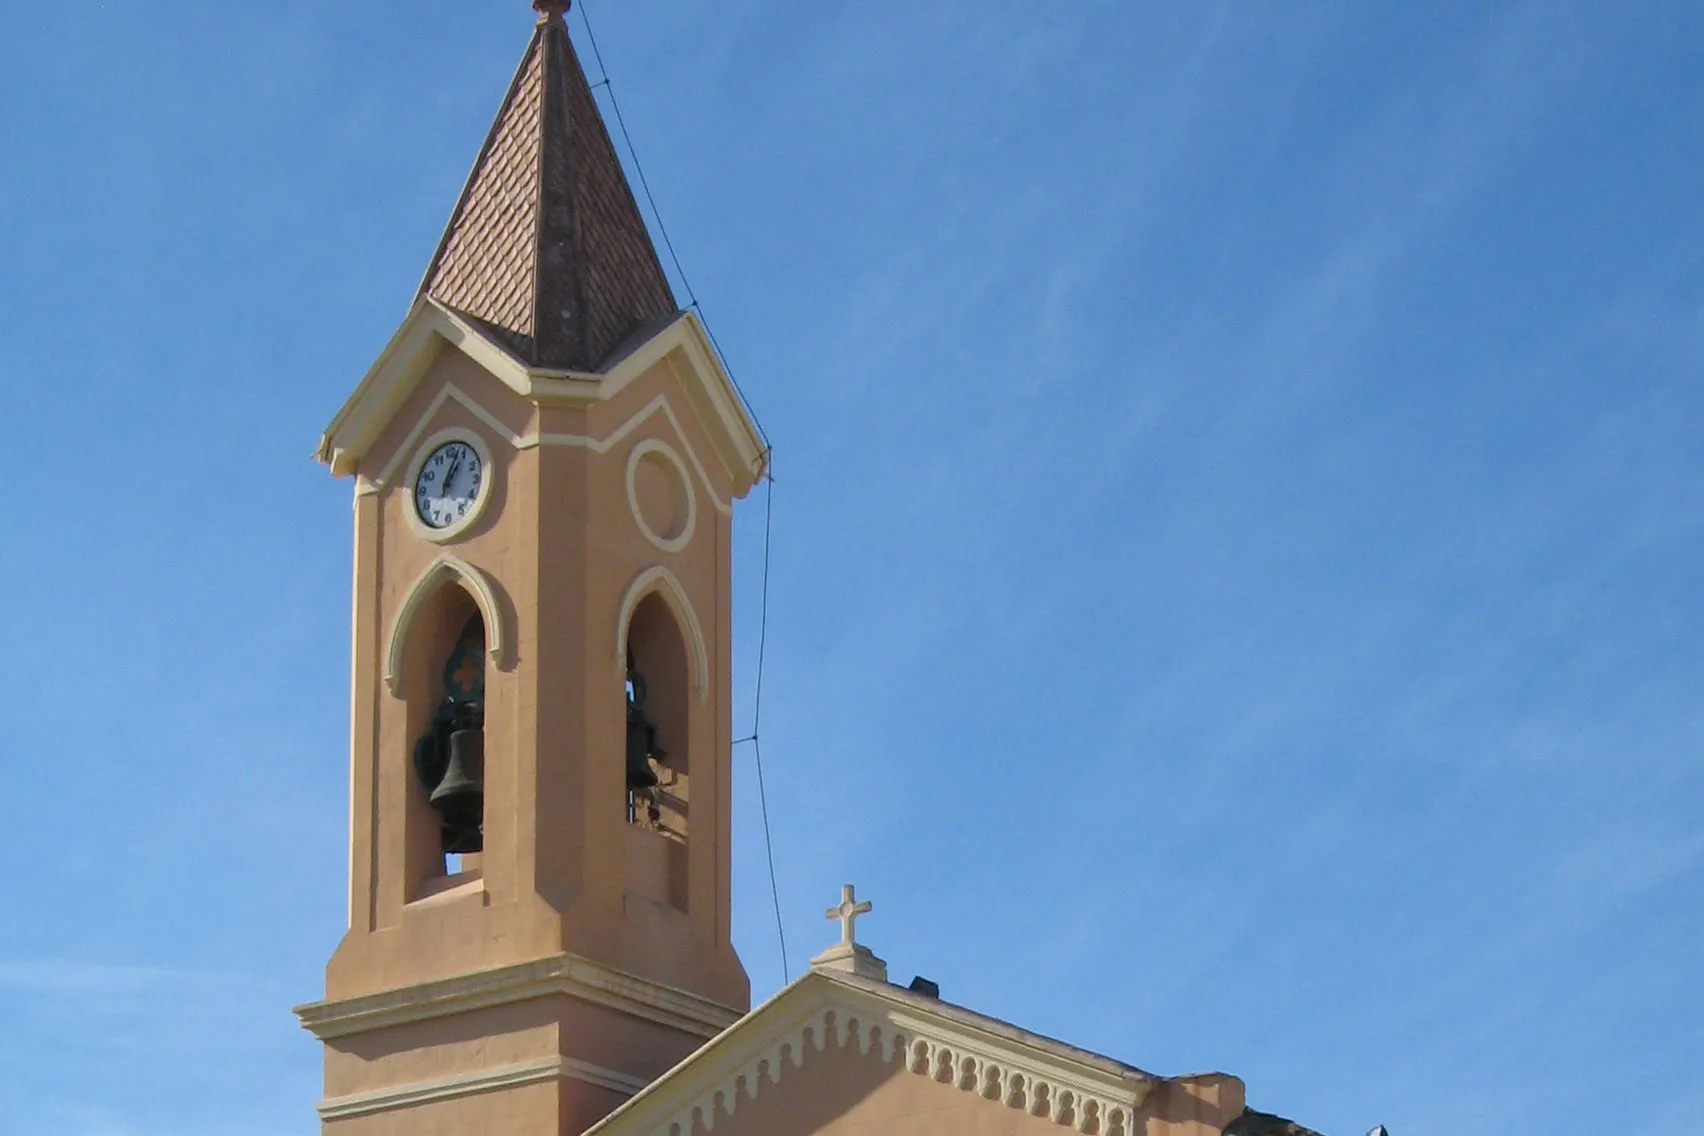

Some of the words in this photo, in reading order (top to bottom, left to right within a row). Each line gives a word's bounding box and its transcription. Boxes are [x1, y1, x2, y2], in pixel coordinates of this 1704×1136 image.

[461, 448, 466, 460] 1
[469, 460, 475, 471] 2
[423, 471, 434, 482] 10
[434, 510, 441, 521] 7
